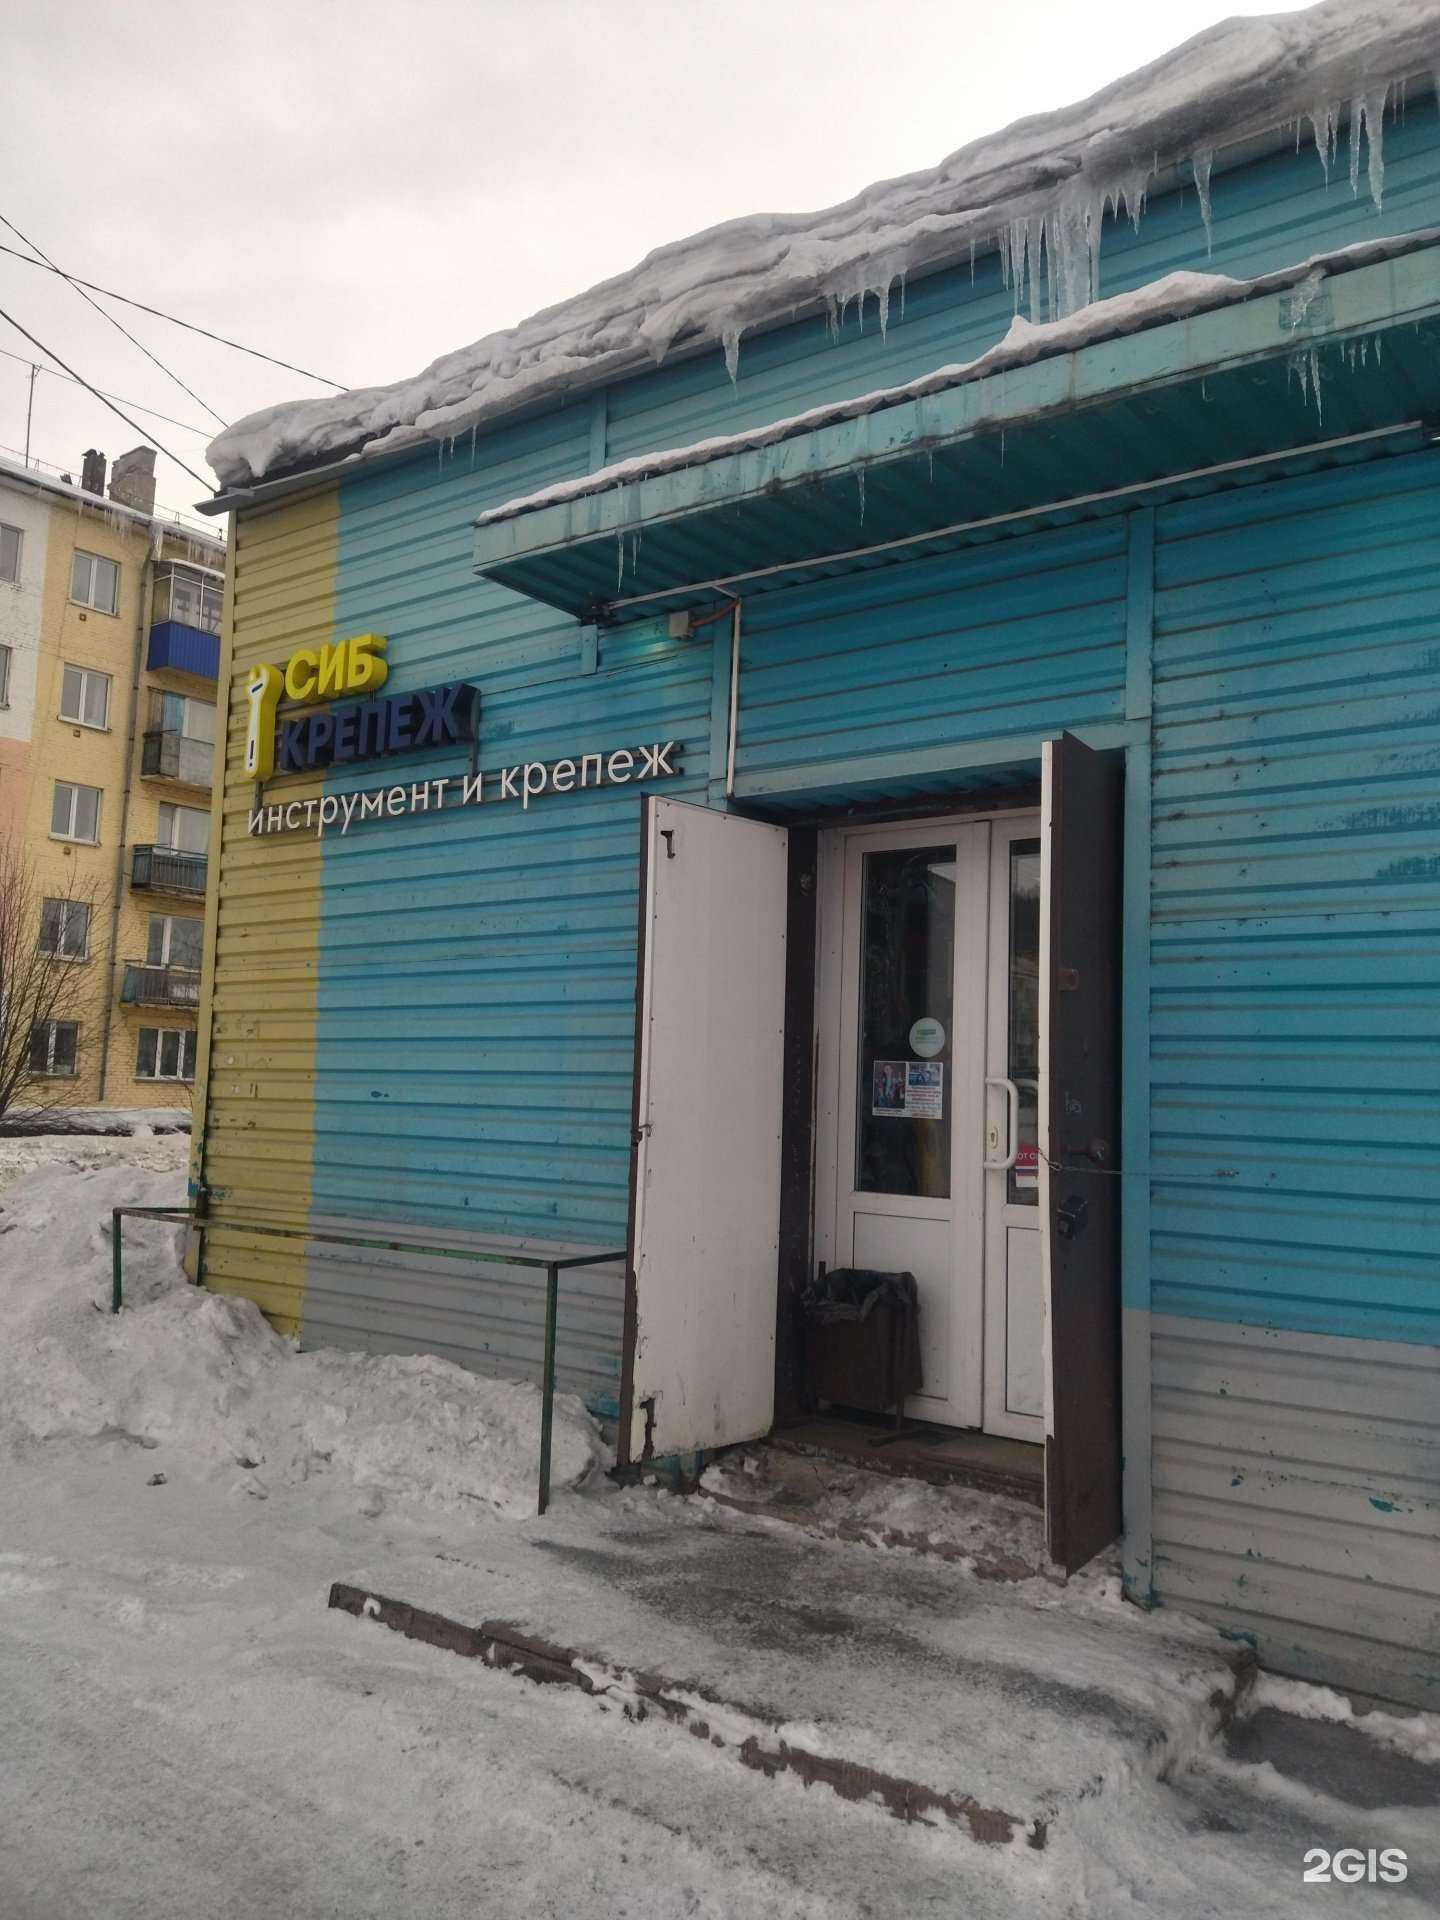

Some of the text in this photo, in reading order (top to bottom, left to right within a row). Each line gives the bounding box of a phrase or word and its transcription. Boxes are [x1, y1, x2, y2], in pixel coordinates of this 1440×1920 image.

[285, 634, 388, 699] СИБ
[278, 683, 474, 771] КРЕПЕЖ
[248, 741, 675, 836] инструмент и крепеж
